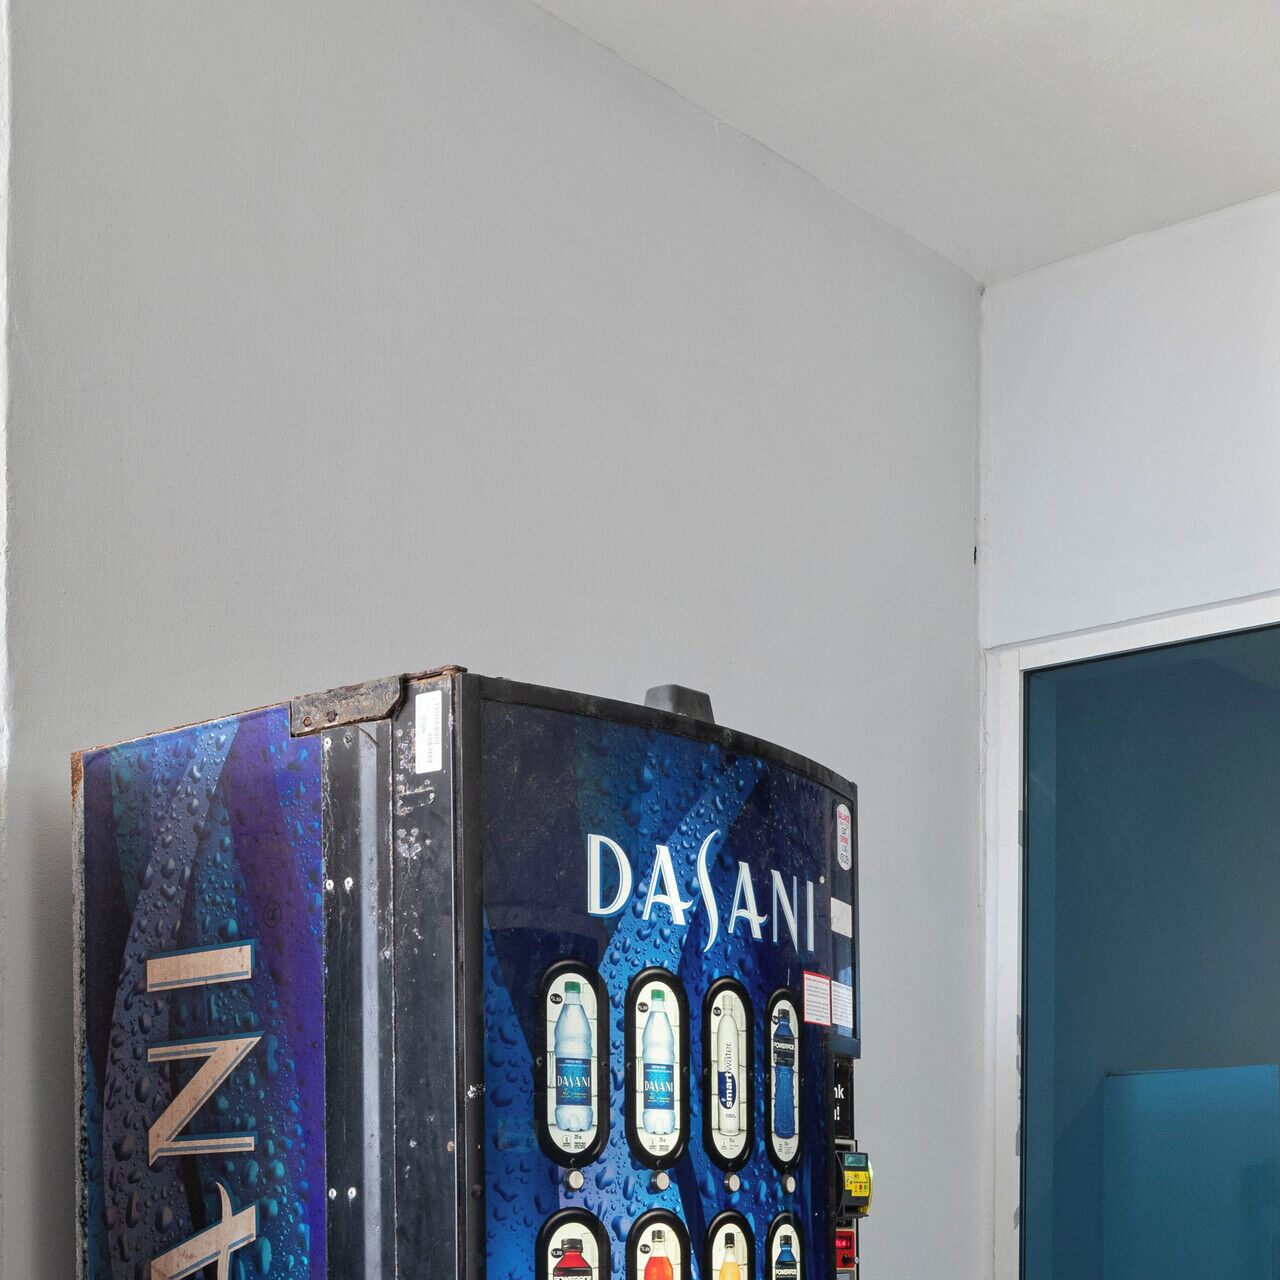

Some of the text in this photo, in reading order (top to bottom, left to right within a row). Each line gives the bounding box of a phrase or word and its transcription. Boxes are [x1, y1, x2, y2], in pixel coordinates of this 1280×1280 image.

[587, 828, 815, 953] DASANI
[557, 1074, 591, 1090] DASANI
[644, 1079, 674, 1093] DASANI
